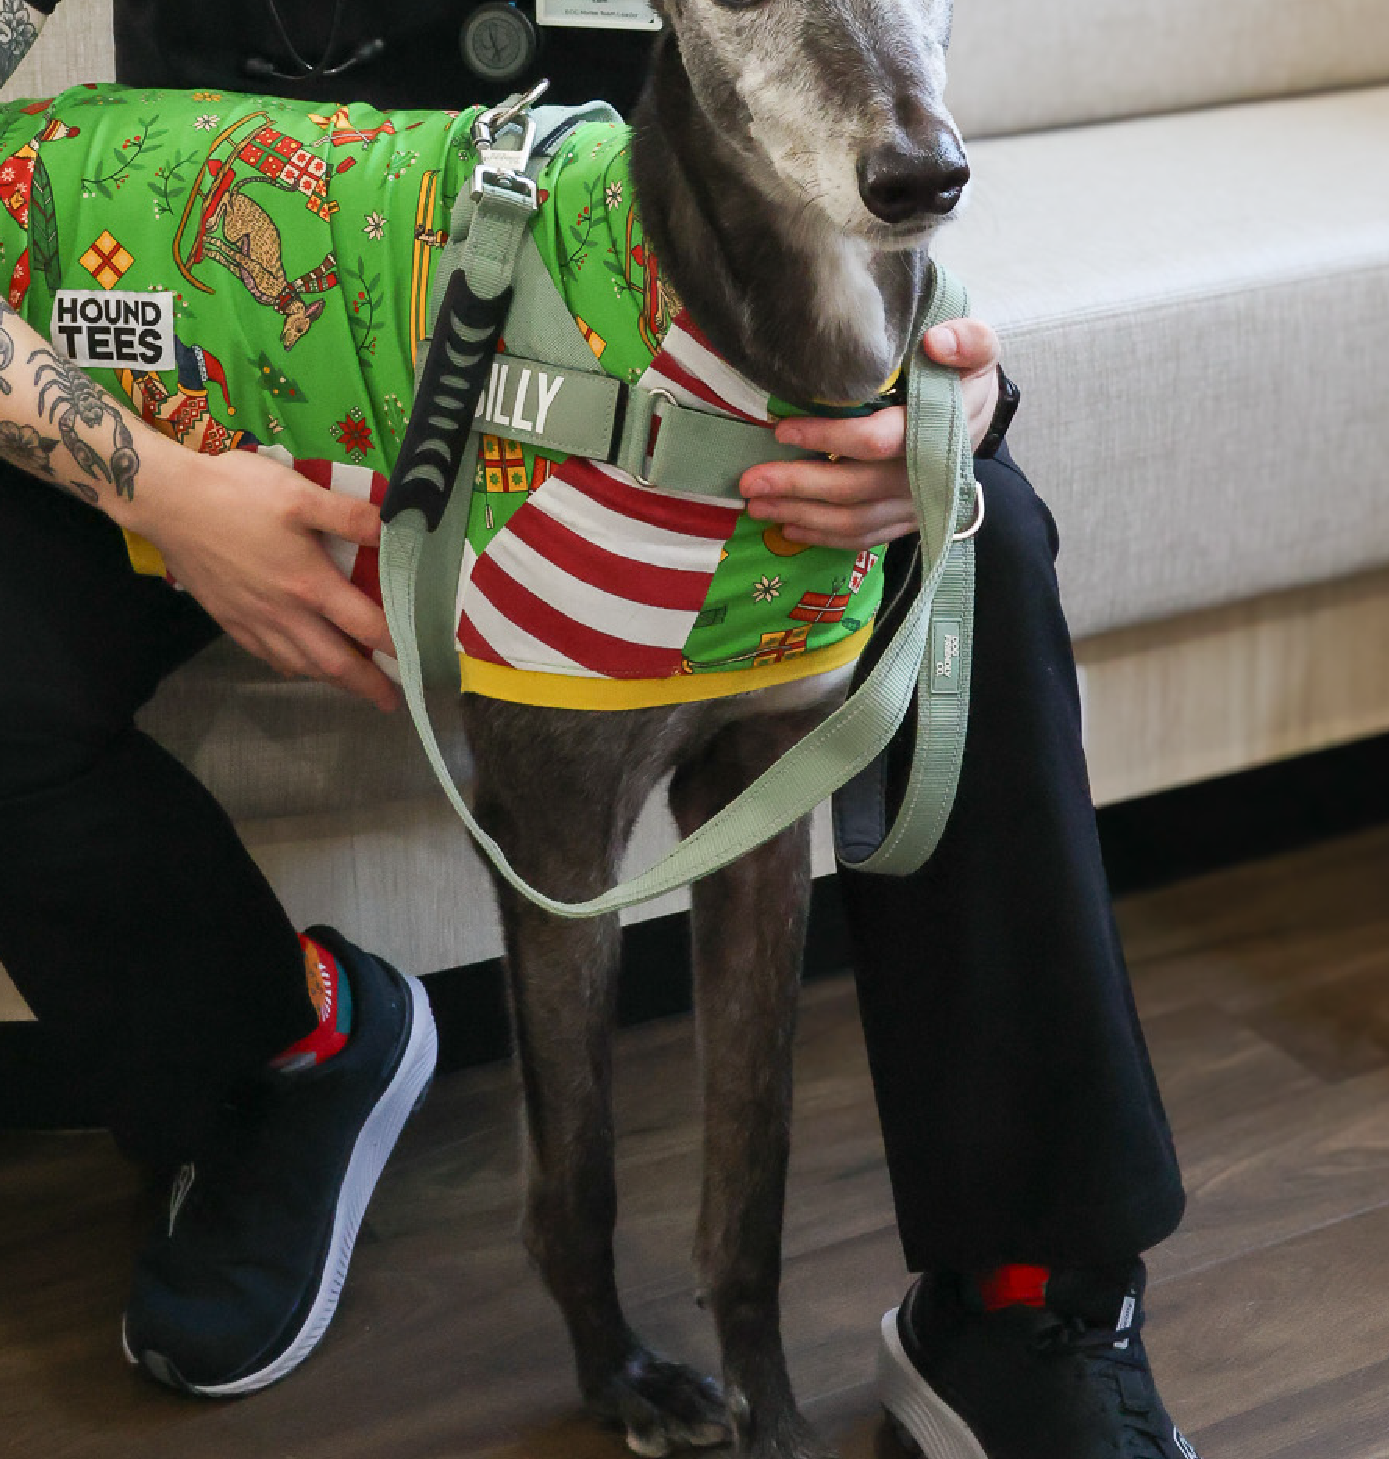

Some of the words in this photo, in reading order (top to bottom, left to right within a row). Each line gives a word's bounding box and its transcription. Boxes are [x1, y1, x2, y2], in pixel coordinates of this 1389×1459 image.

[58, 297, 162, 327] HOUND
[58, 325, 163, 365] TEES
[474, 363, 565, 435] ILLY
